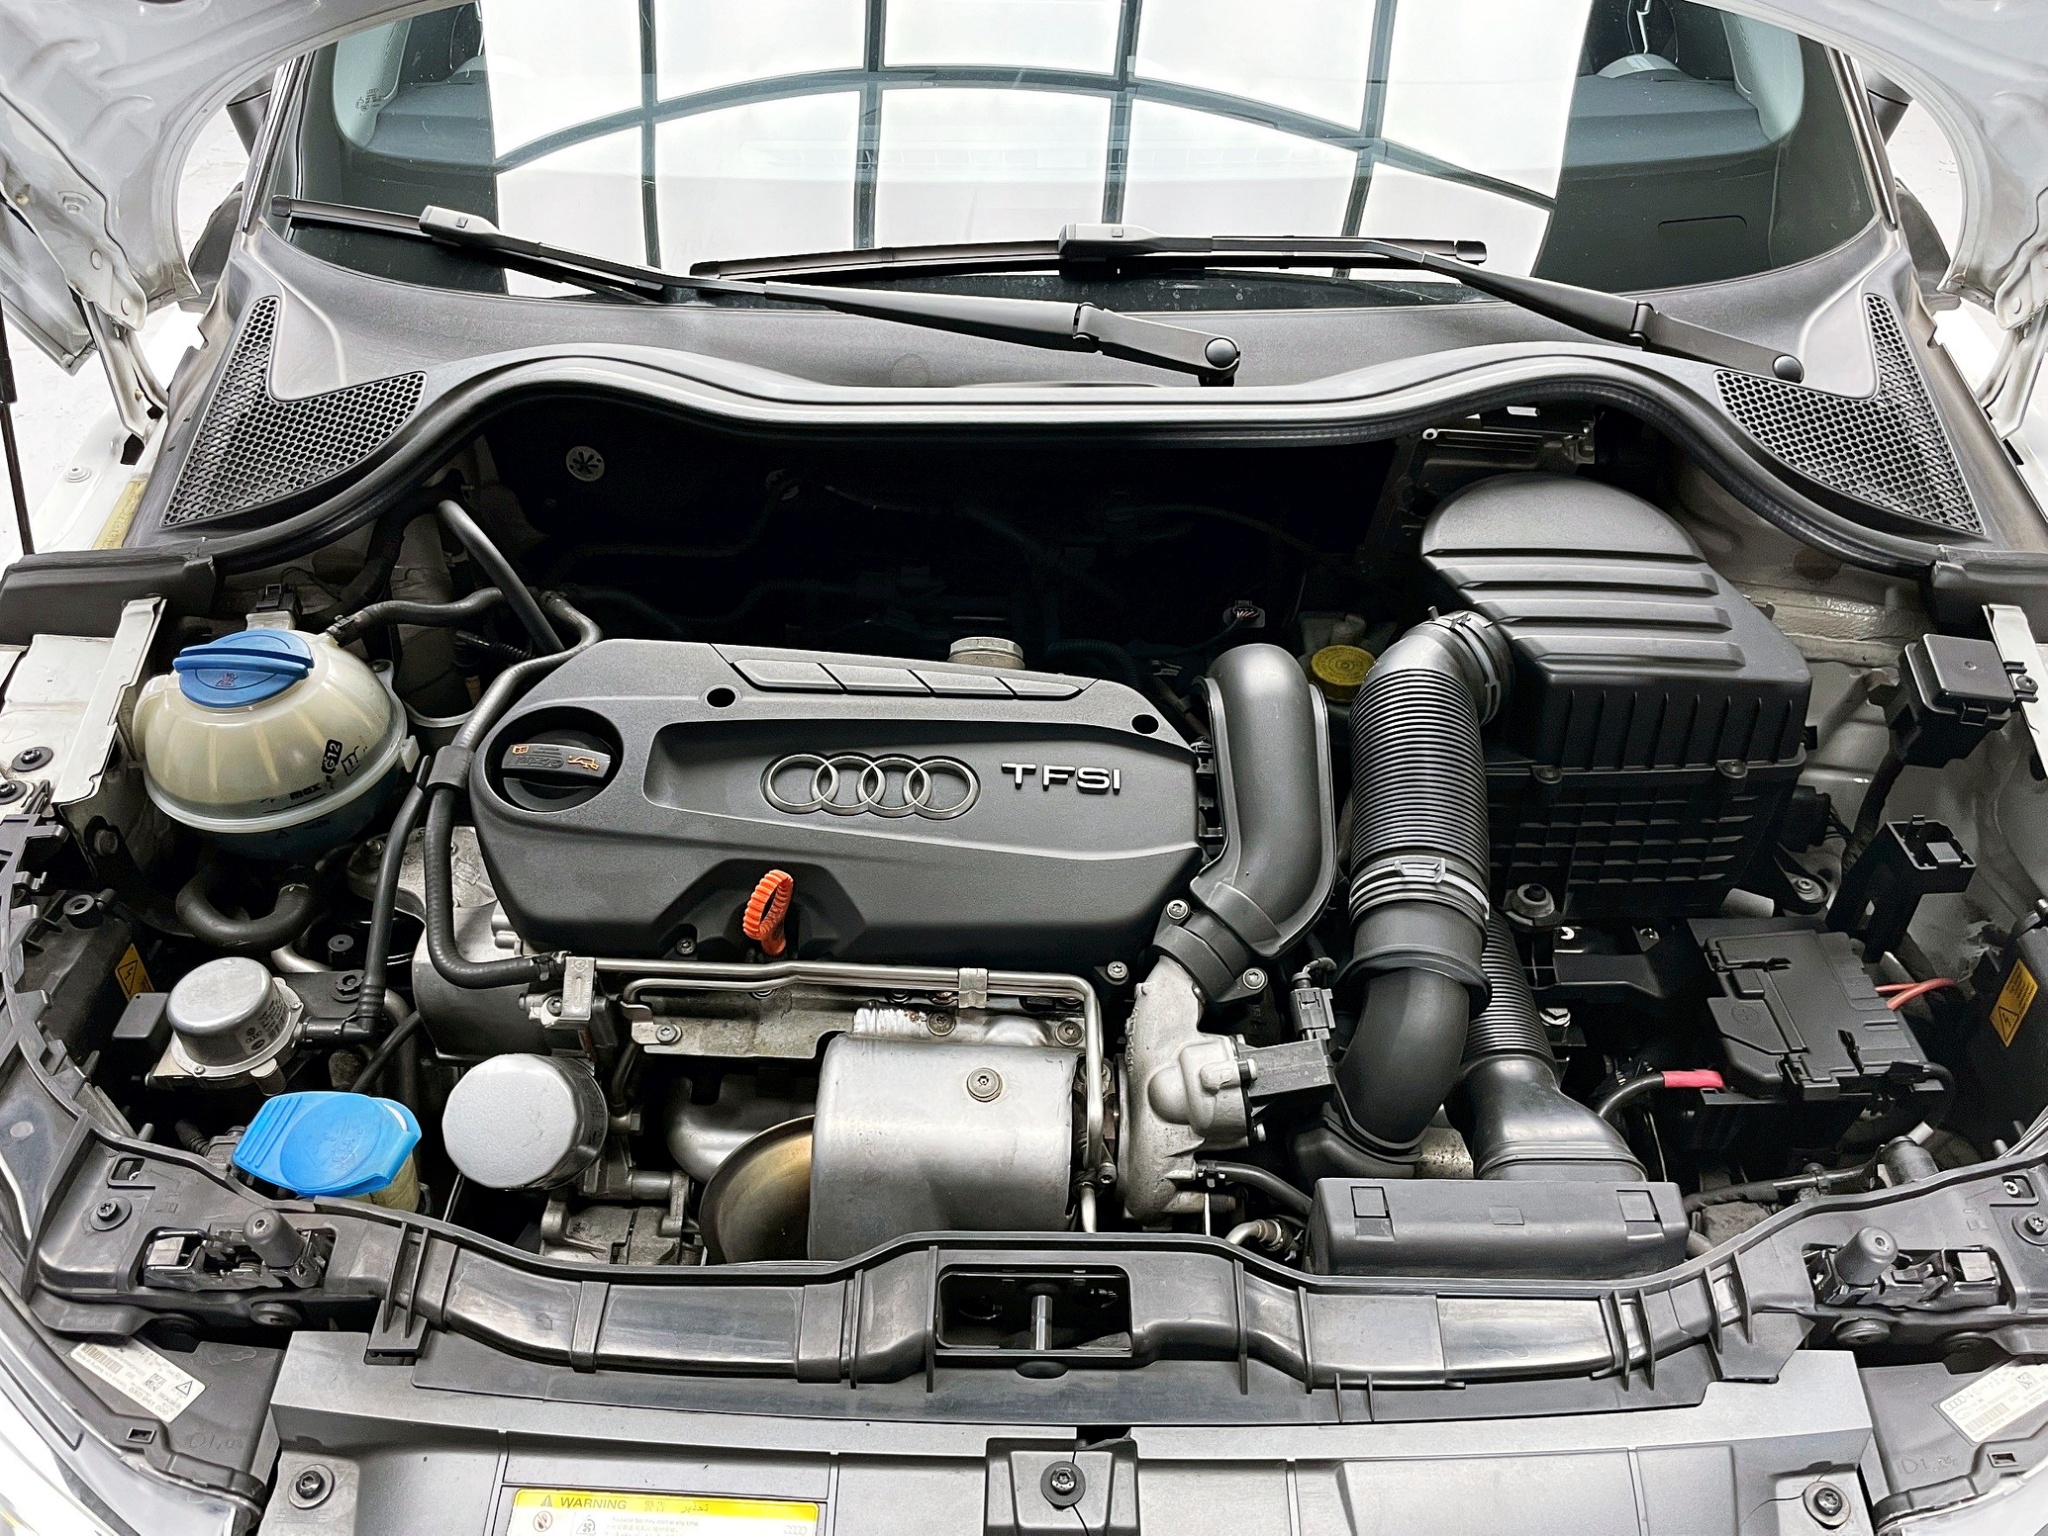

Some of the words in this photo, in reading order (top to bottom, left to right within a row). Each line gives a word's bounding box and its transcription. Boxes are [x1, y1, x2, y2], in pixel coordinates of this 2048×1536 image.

[324, 743, 341, 770] G12
[1001, 762, 1121, 796] TFSI
[289, 783, 322, 800] max
[560, 1496, 627, 1510] WARNING
